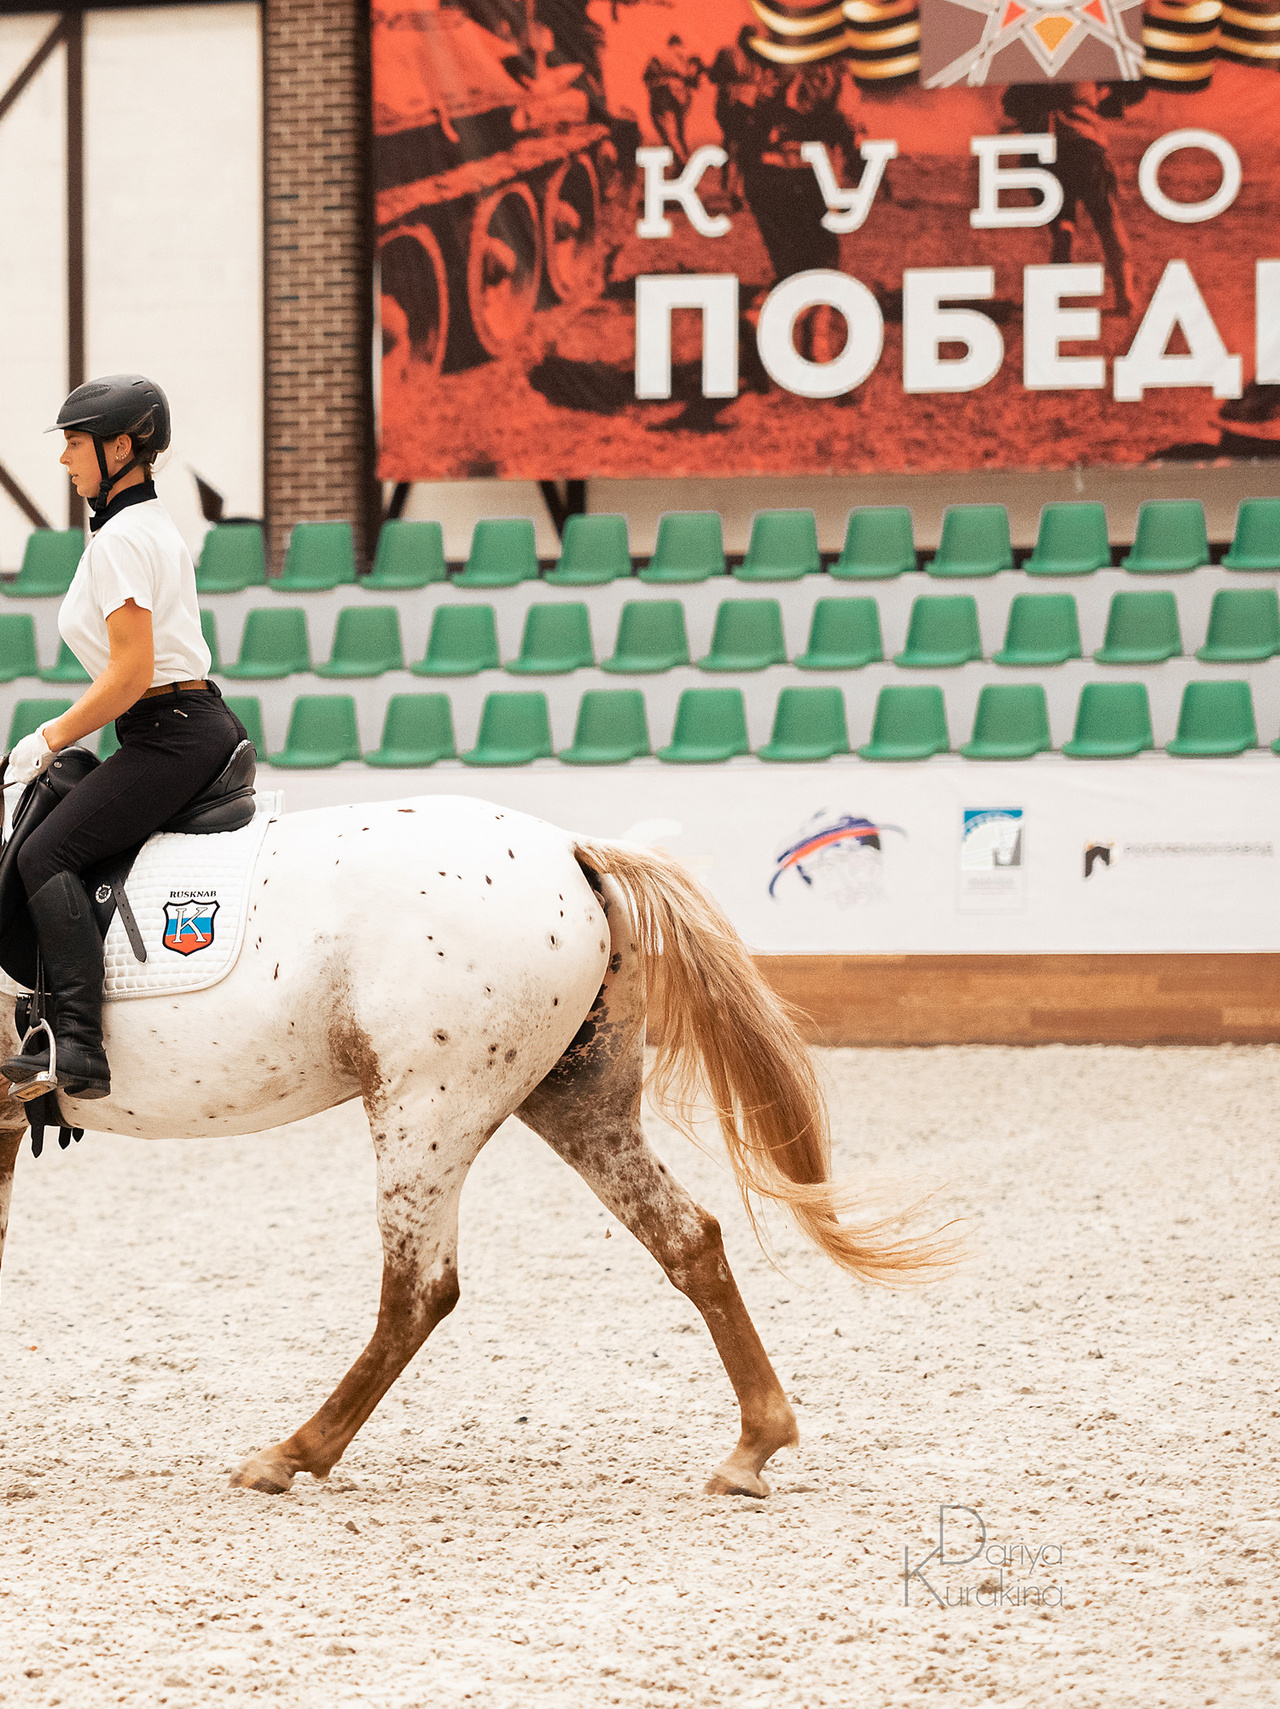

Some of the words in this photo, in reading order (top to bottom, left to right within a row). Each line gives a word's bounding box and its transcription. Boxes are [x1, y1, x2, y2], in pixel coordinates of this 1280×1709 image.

[635, 128, 1243, 239] КУБО
[635, 257, 1280, 402] ПОБЕД
[169, 890, 217, 899] RUSKNAB
[172, 907, 209, 943] K
